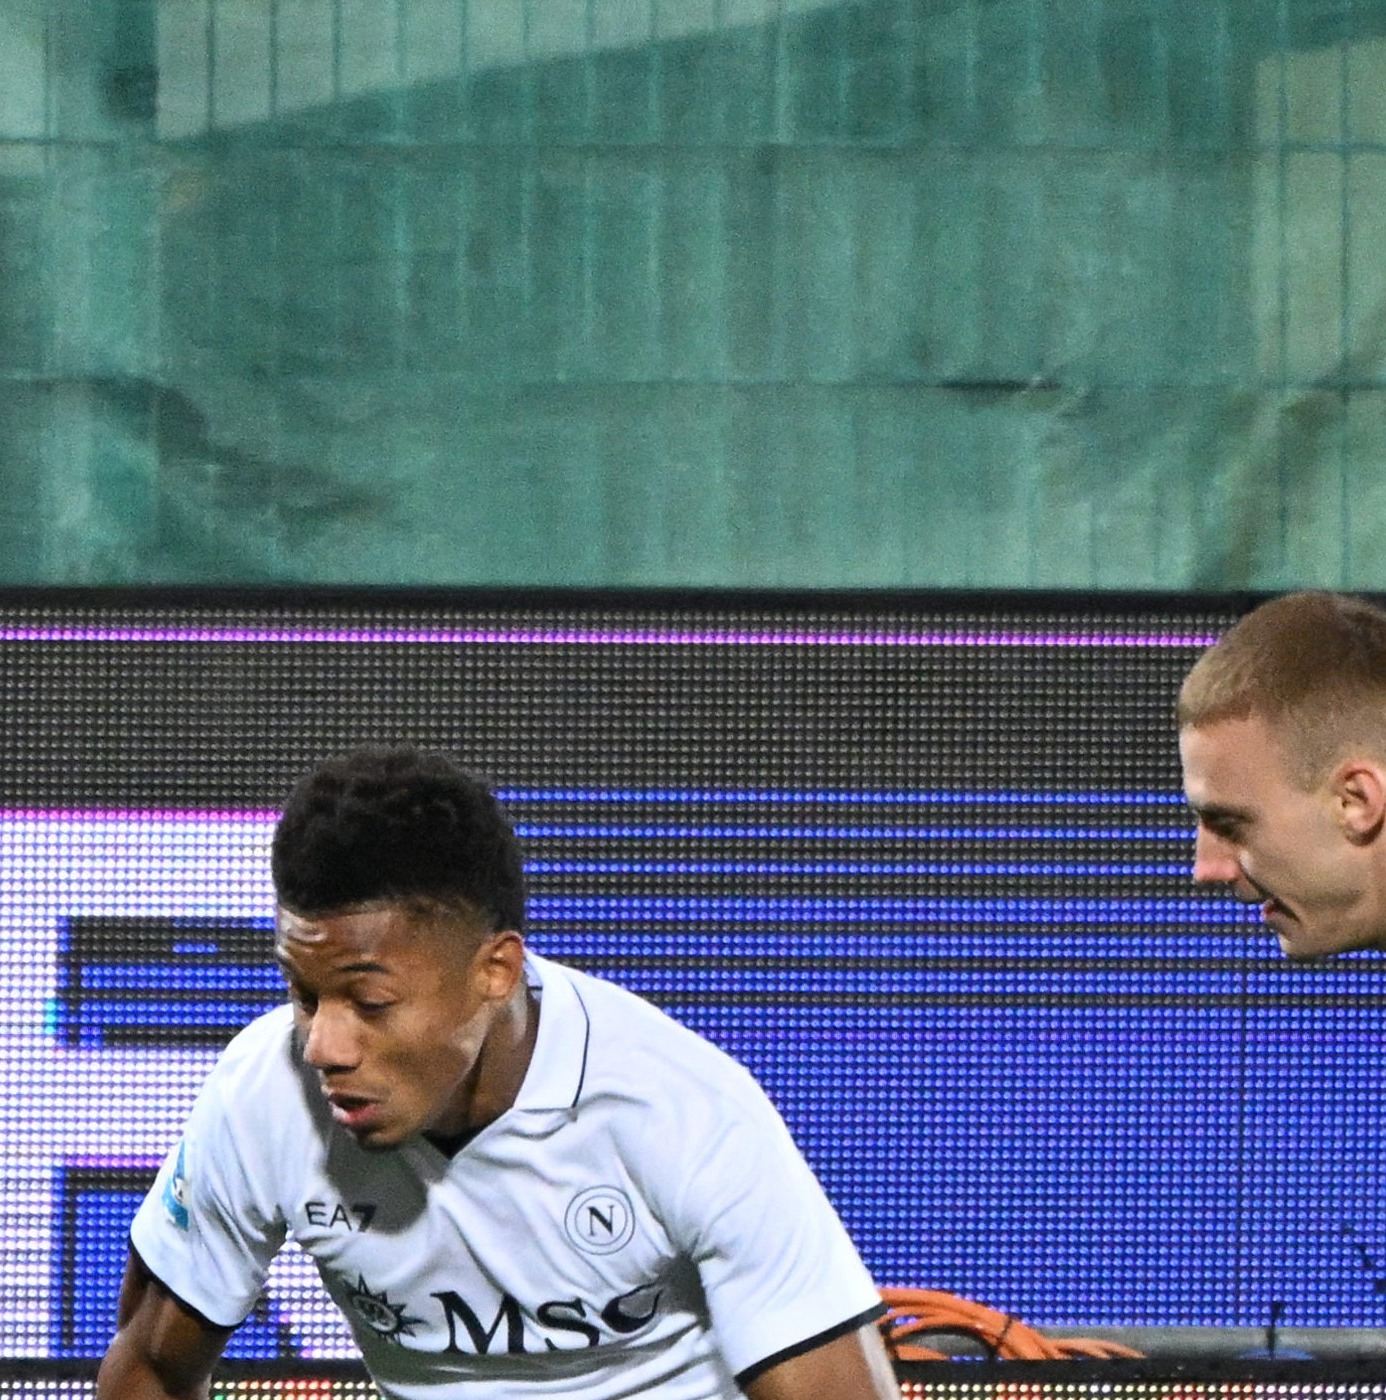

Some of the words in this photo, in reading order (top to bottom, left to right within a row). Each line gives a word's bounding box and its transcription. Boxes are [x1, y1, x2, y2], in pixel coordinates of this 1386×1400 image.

[305, 1201, 377, 1232] EA7
[587, 1204, 615, 1238] N
[429, 1281, 664, 1354] MSC
